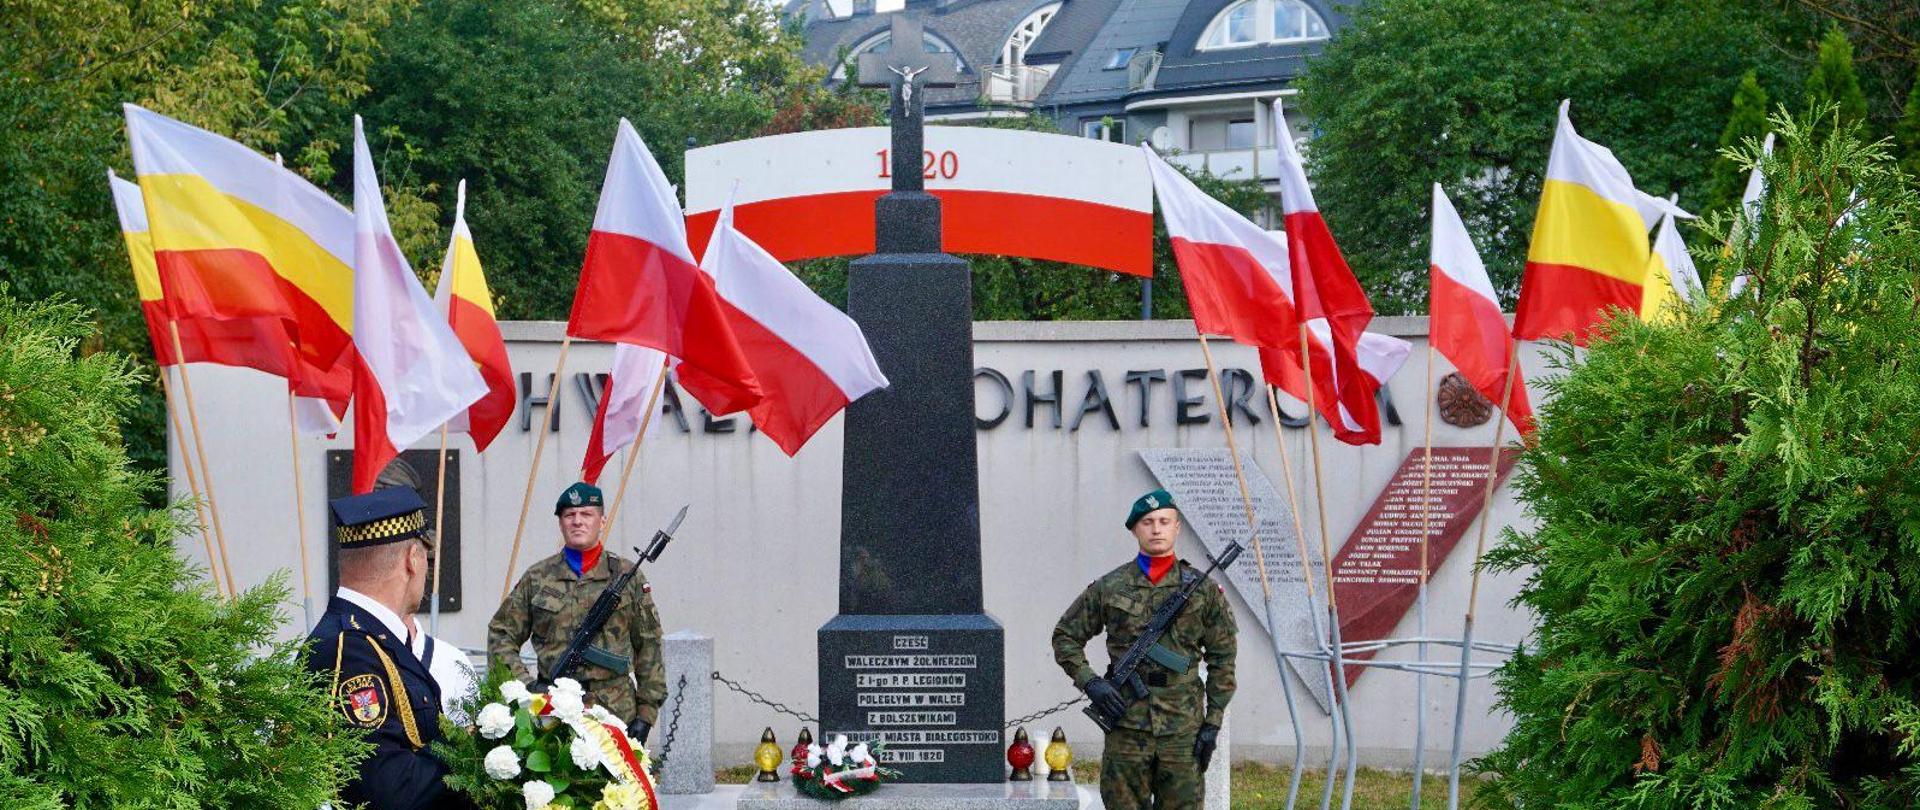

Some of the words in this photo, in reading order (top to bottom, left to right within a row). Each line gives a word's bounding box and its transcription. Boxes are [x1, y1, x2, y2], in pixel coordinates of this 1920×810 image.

[875, 149, 958, 179] 120
[973, 367, 1402, 431] OHATERO
[1421, 455, 1450, 463] MCHAŁ
[1415, 463, 1460, 471] FRNCISZEK
[1408, 471, 1447, 479] STANSŁAW
[847, 656, 910, 666] WALECZNYM
[859, 676, 864, 685] Z
[859, 695, 911, 704] POLEGŁYM
[915, 695, 924, 704] W
[929, 695, 962, 704] WALCE
[870, 714, 876, 723] Z
[880, 714, 954, 723] BOLSZEWIKAMI
[885, 732, 922, 742] MIASTA
[925, 732, 997, 742] BIAŁEGOSTOKU
[882, 751, 894, 761] 22
[899, 751, 914, 761] VIII
[919, 751, 942, 761] 1920
